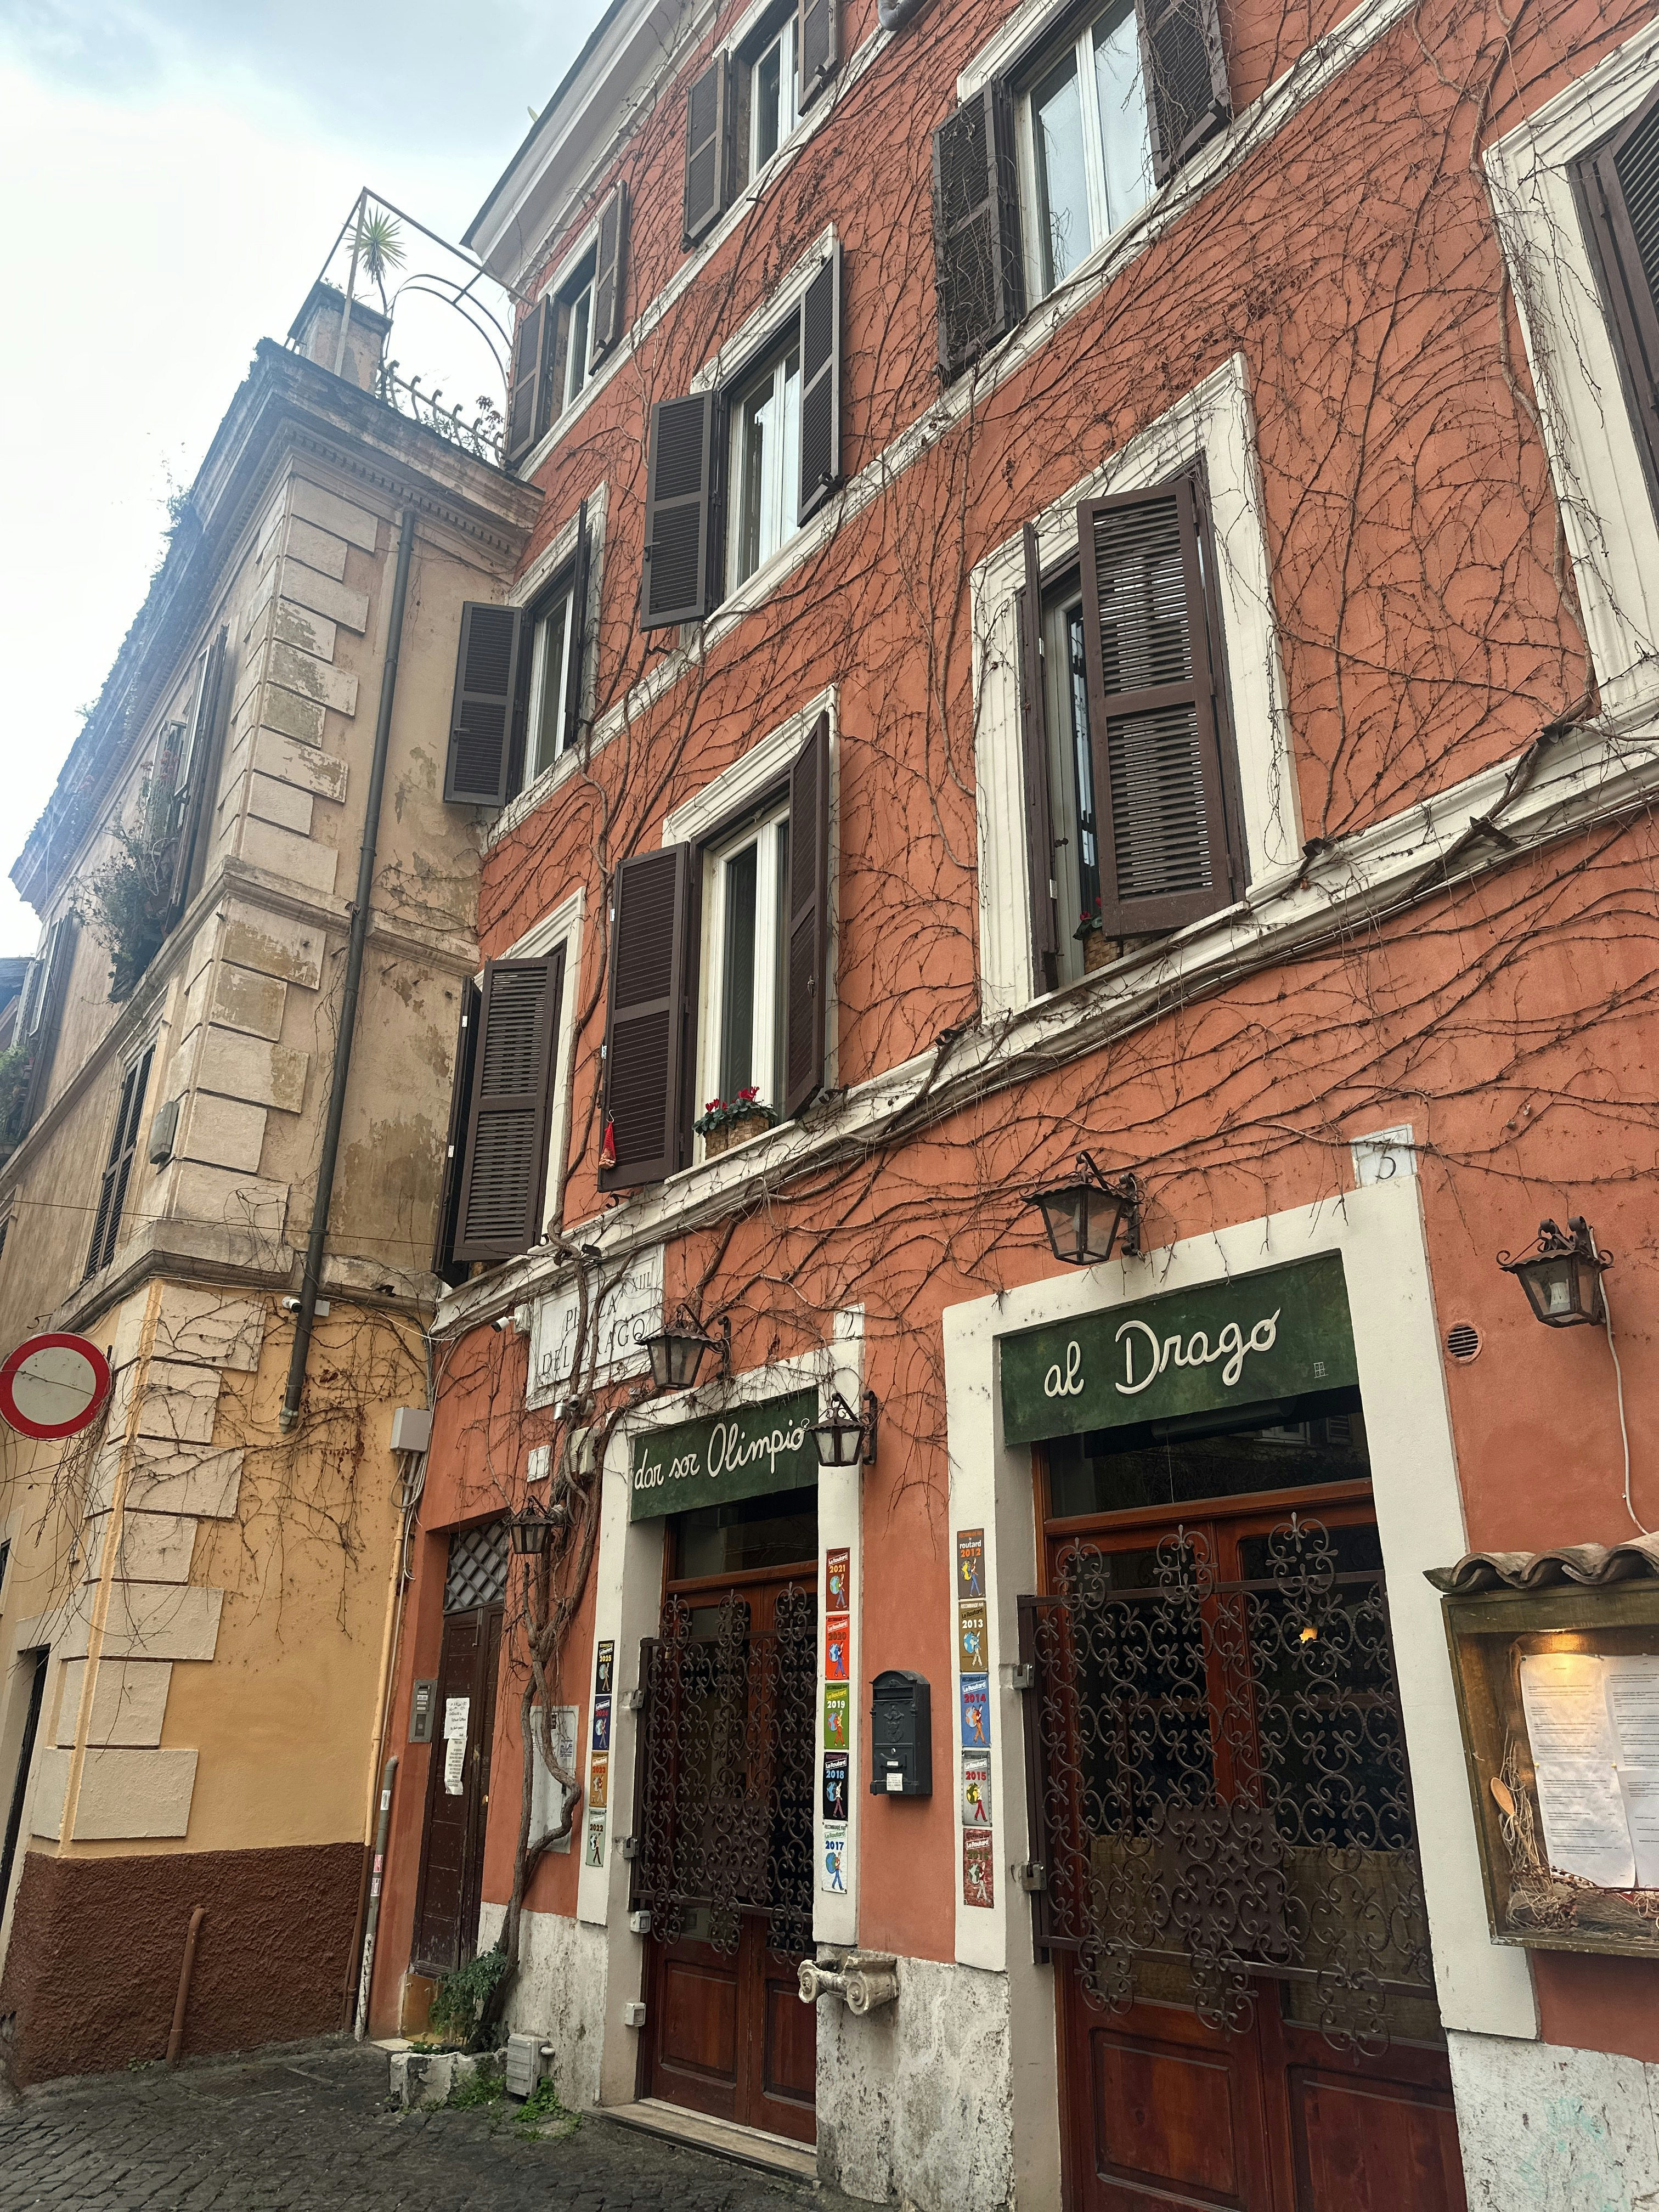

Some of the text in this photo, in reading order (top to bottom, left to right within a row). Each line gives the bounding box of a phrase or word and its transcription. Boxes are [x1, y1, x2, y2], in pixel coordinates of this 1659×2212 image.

[1045, 1307, 1280, 1397] al Drago
[542, 1346, 569, 1375] DEL
[635, 1448, 664, 1490] dar
[669, 1453, 700, 1479] sor
[960, 1540, 981, 1549] routard
[961, 1548, 981, 1558] 2012
[829, 1565, 845, 1573] 2021
[967, 1608, 983, 1617] Routard
[962, 1619, 983, 1628] 2013
[828, 1632, 847, 1640] 2020
[968, 1681, 986, 1691] Routard
[964, 1694, 986, 1703] 2014
[827, 1700, 845, 1708] 2019
[969, 1760, 986, 1769] Routard
[826, 1770, 844, 1779] 2018
[966, 1771, 986, 1780] 2015
[825, 1841, 844, 1851] 2017
[971, 1839, 989, 1847] Routard
[967, 1849, 989, 1859] 2016
